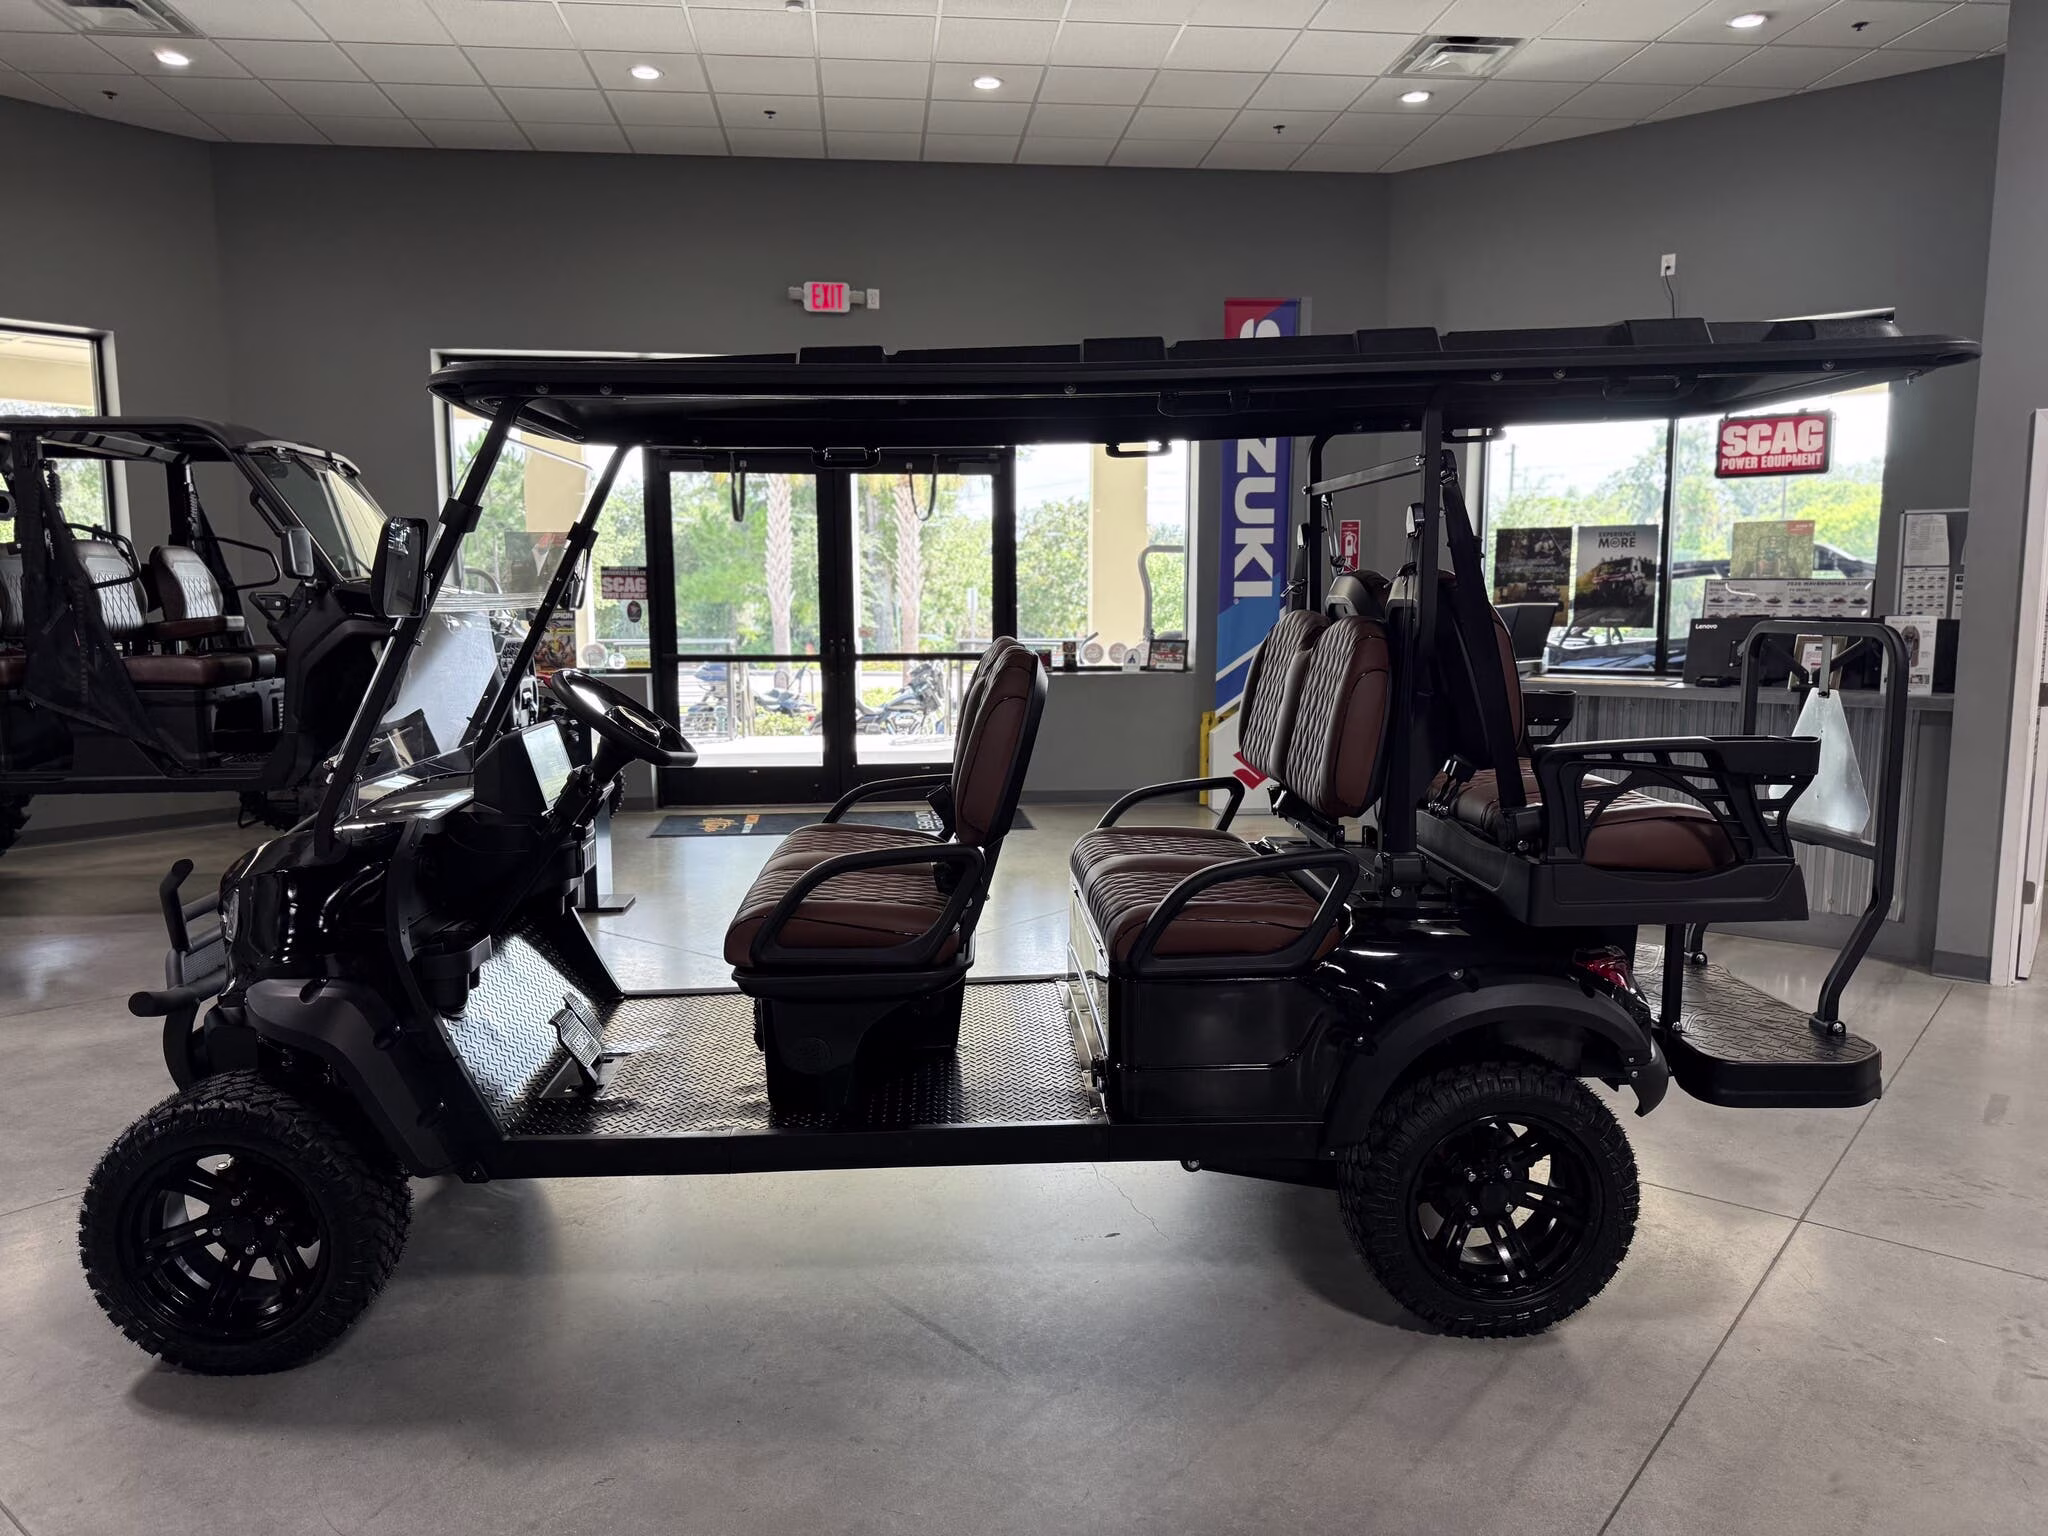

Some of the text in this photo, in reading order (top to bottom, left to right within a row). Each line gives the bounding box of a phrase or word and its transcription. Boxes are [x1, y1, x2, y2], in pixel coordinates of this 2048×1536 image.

[812, 283, 845, 310] EXIT
[1721, 419, 1825, 457] SCAG
[1233, 318, 1281, 598] ZUKI
[1721, 452, 1823, 471] POWER EQUIPMENT
[1597, 537, 1637, 549] MORE
[602, 577, 647, 592] SCAG
